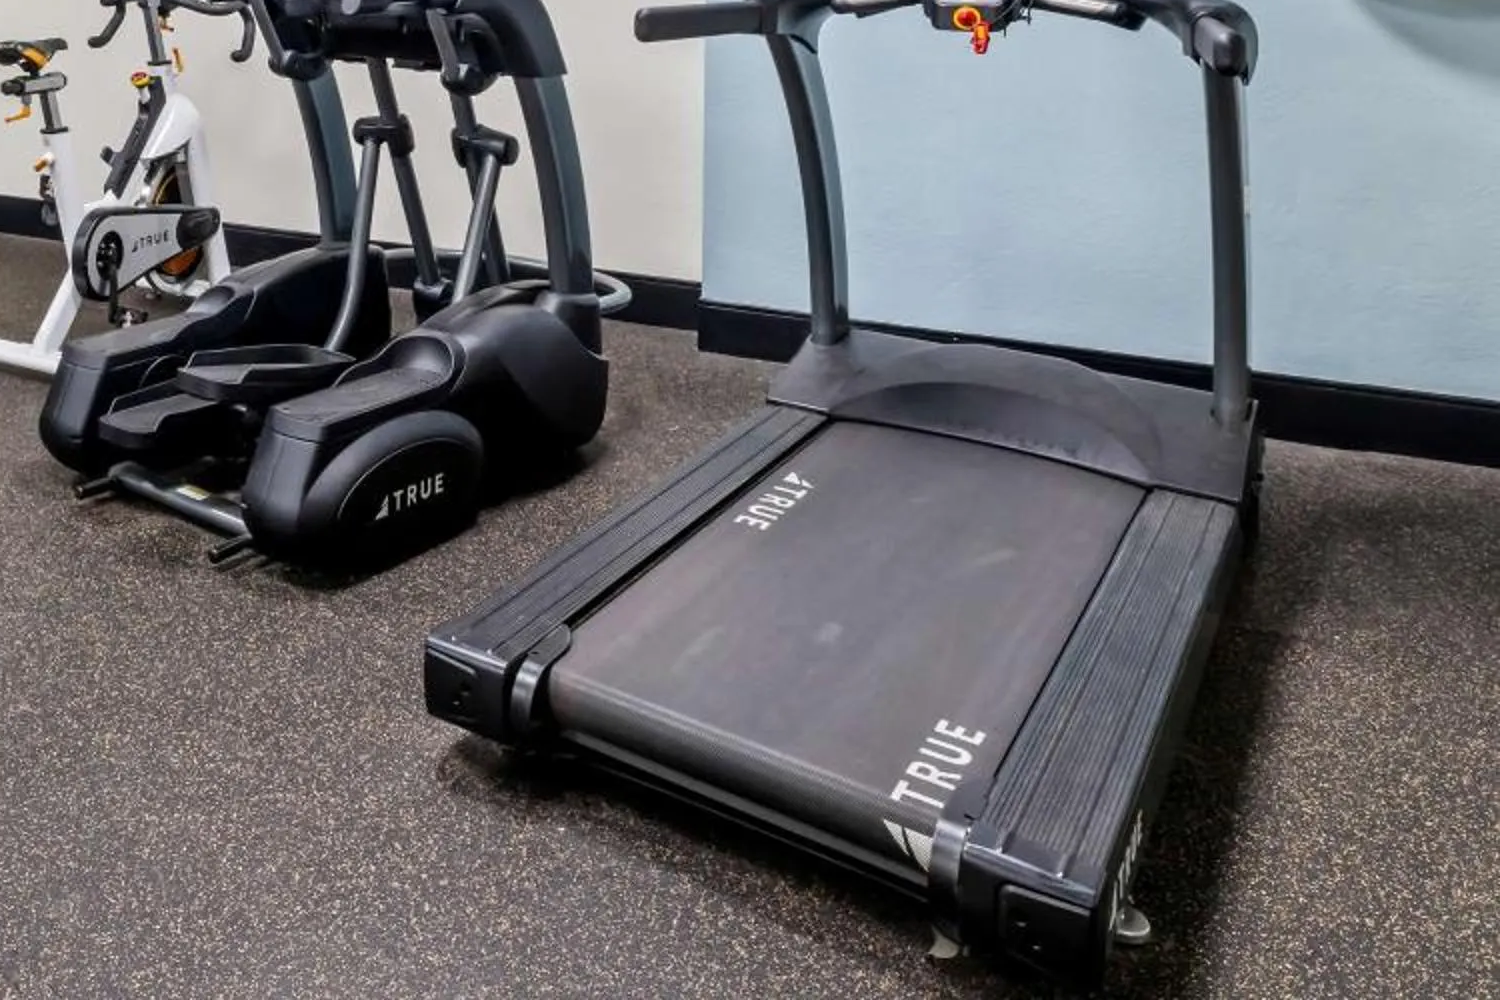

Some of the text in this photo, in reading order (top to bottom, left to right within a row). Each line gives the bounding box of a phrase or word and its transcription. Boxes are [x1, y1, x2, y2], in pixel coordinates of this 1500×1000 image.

[140, 228, 170, 249] TRUE
[392, 472, 445, 512] TRUE
[733, 485, 808, 531] TRUE
[890, 718, 987, 809] TRUE
